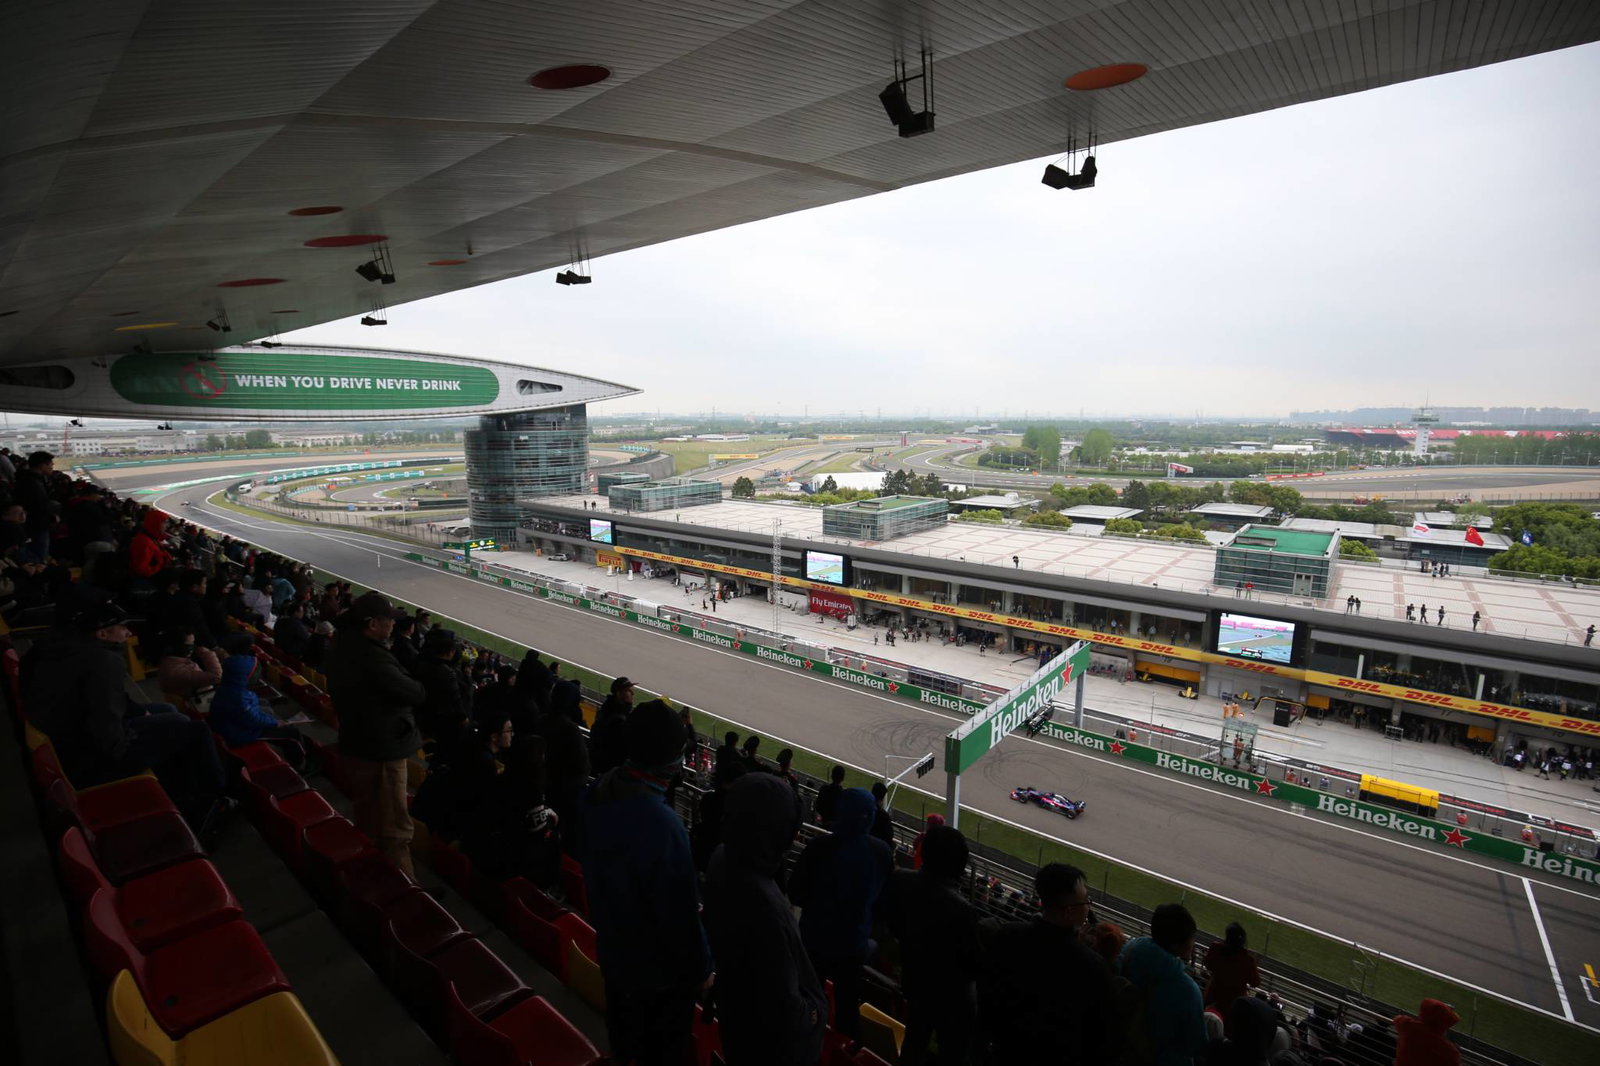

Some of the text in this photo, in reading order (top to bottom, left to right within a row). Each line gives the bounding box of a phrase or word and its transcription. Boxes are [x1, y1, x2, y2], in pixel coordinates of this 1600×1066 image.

[235, 375, 462, 390] WHEN YOU DRIVE NEVER DRINK
[746, 570, 762, 578] DHL
[548, 590, 574, 604] Heineken
[812, 596, 823, 606] Fly
[866, 592, 888, 601] DHL
[898, 598, 921, 608] DHL
[590, 602, 620, 617] Heineken
[932, 604, 956, 614] DHL
[968, 611, 994, 620] DHL
[637, 614, 671, 631] Heineken
[1007, 618, 1035, 628] DHL
[692, 628, 731, 648] Heineken
[1048, 626, 1078, 636] DHL
[1093, 634, 1124, 646] DHL
[1140, 642, 1174, 654] DHL
[756, 646, 802, 668] Heineken
[1225, 659, 1278, 674] DHL
[832, 666, 885, 691] Heineken
[1337, 678, 1382, 692] DHL
[1405, 690, 1454, 706] DHL
[990, 676, 1058, 750] Heineken
[1478, 704, 1532, 720] DHL
[1040, 724, 1105, 750] eineken
[1156, 752, 1250, 790] Heineken
[1316, 794, 1436, 840] Heineken
